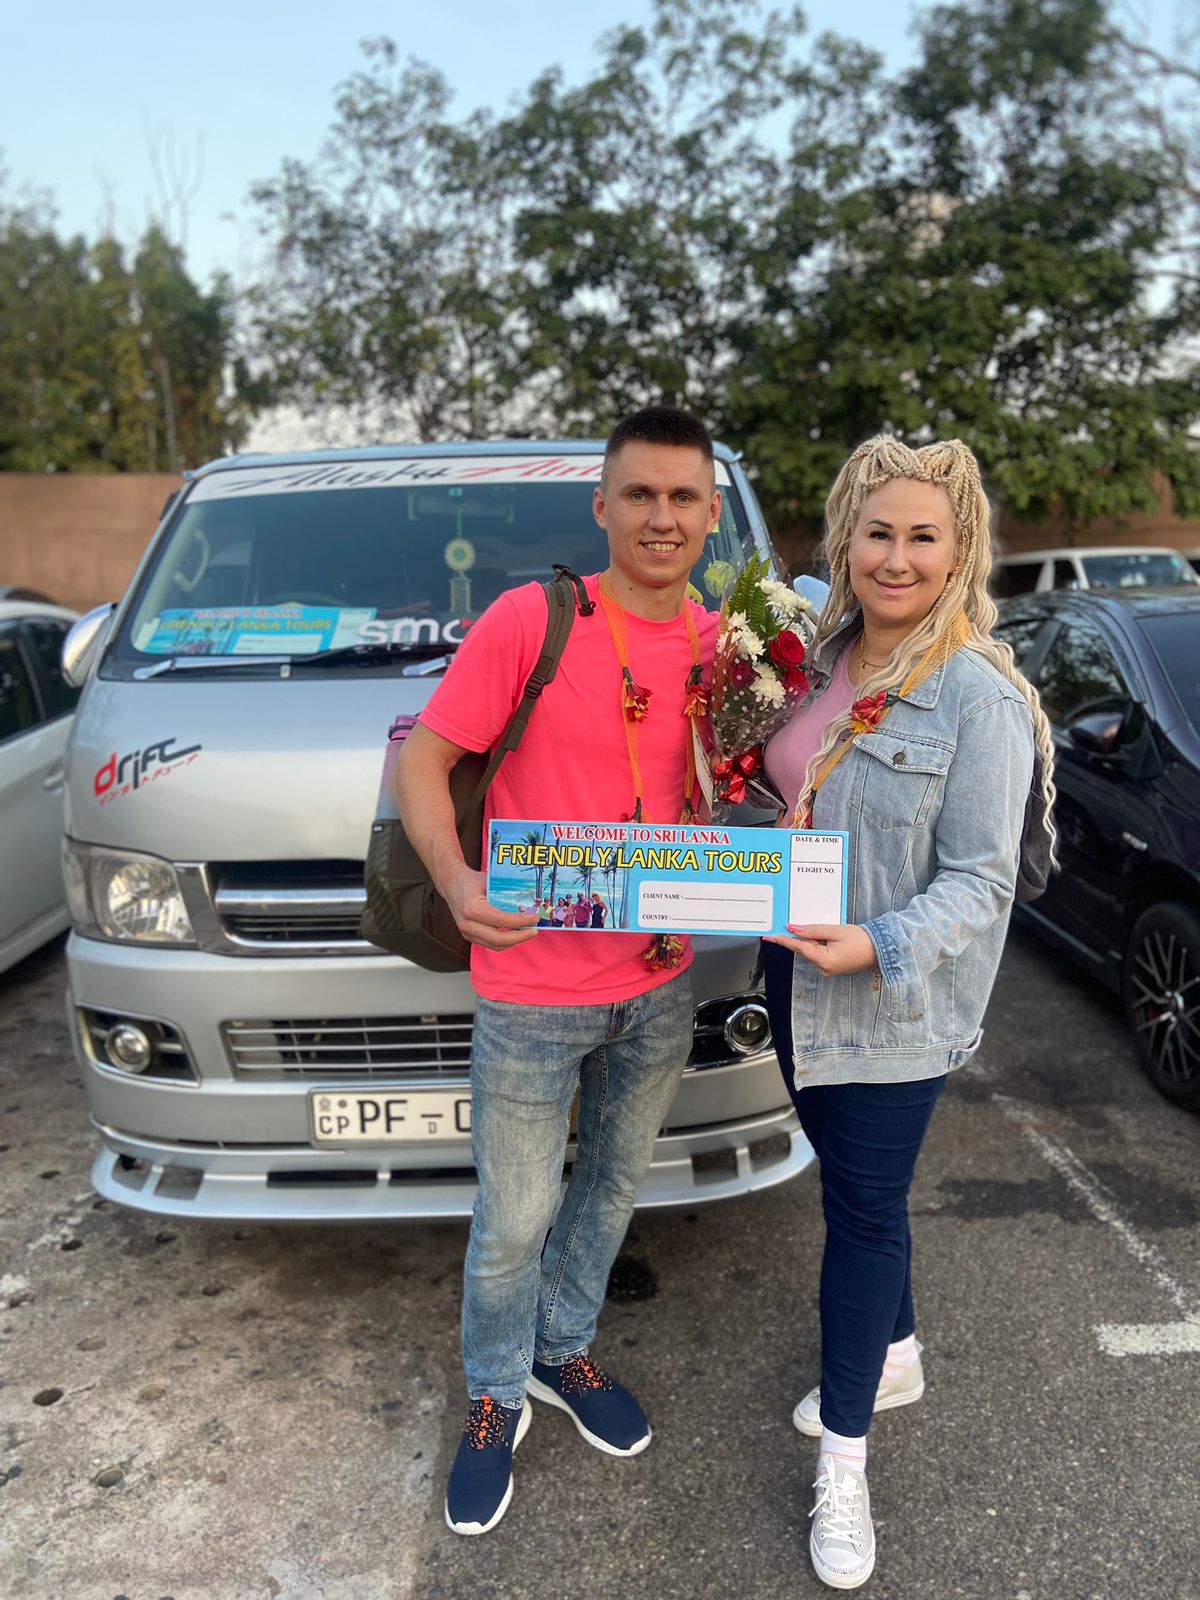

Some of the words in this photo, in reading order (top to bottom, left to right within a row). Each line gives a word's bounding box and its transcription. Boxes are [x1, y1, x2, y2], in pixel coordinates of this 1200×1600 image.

[456, 458, 604, 480] Airl
[552, 825, 628, 841] WELCOME
[631, 828, 651, 842] TO
[653, 829, 678, 844] SRI
[680, 830, 731, 845] LANKA
[496, 843, 612, 868] FRIENDLY
[615, 847, 699, 871] LANKA
[703, 850, 783, 874] TOURS
[797, 866, 823, 874] FLIGHT
[823, 867, 837, 875] NO.
[642, 892, 664, 900] CLIENT
[641, 913, 668, 921] COUNTRY
[319, 1115, 350, 1135] CP
[427, 1121, 438, 1134] D
